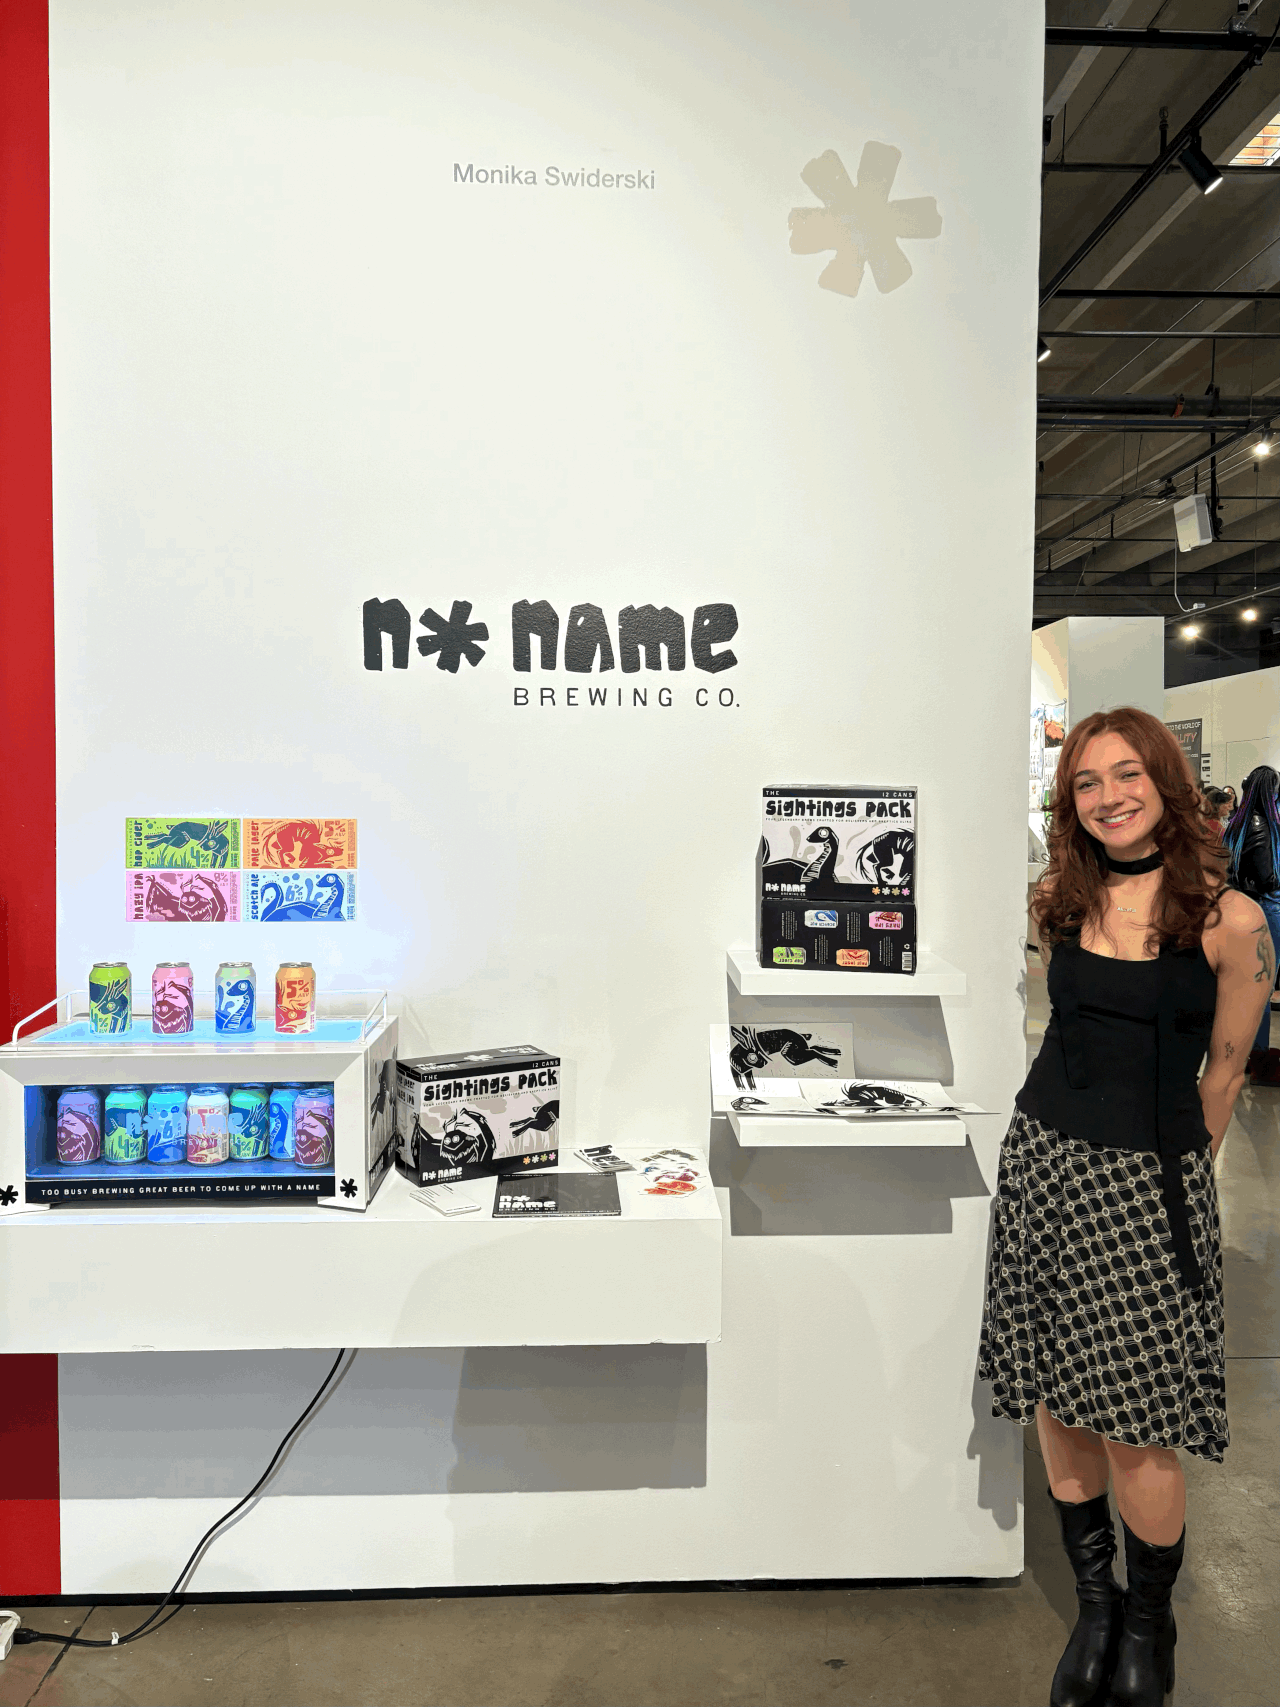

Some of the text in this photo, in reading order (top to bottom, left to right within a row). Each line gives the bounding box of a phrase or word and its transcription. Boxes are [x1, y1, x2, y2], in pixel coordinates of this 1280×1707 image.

[453, 162, 655, 190] Monika Swiderski
[513, 687, 741, 708] BREWING CO.
[286, 980, 310, 998] 5%
[64, 1188, 89, 1196] BUSY
[92, 1187, 135, 1195] BREWING
[139, 1186, 168, 1194] GREAT
[172, 1185, 196, 1193] BEER
[215, 1184, 241, 1192] COME
[260, 1183, 283, 1191] WITH
[286, 1183, 292, 1191] A
[296, 1183, 321, 1191] NAME
